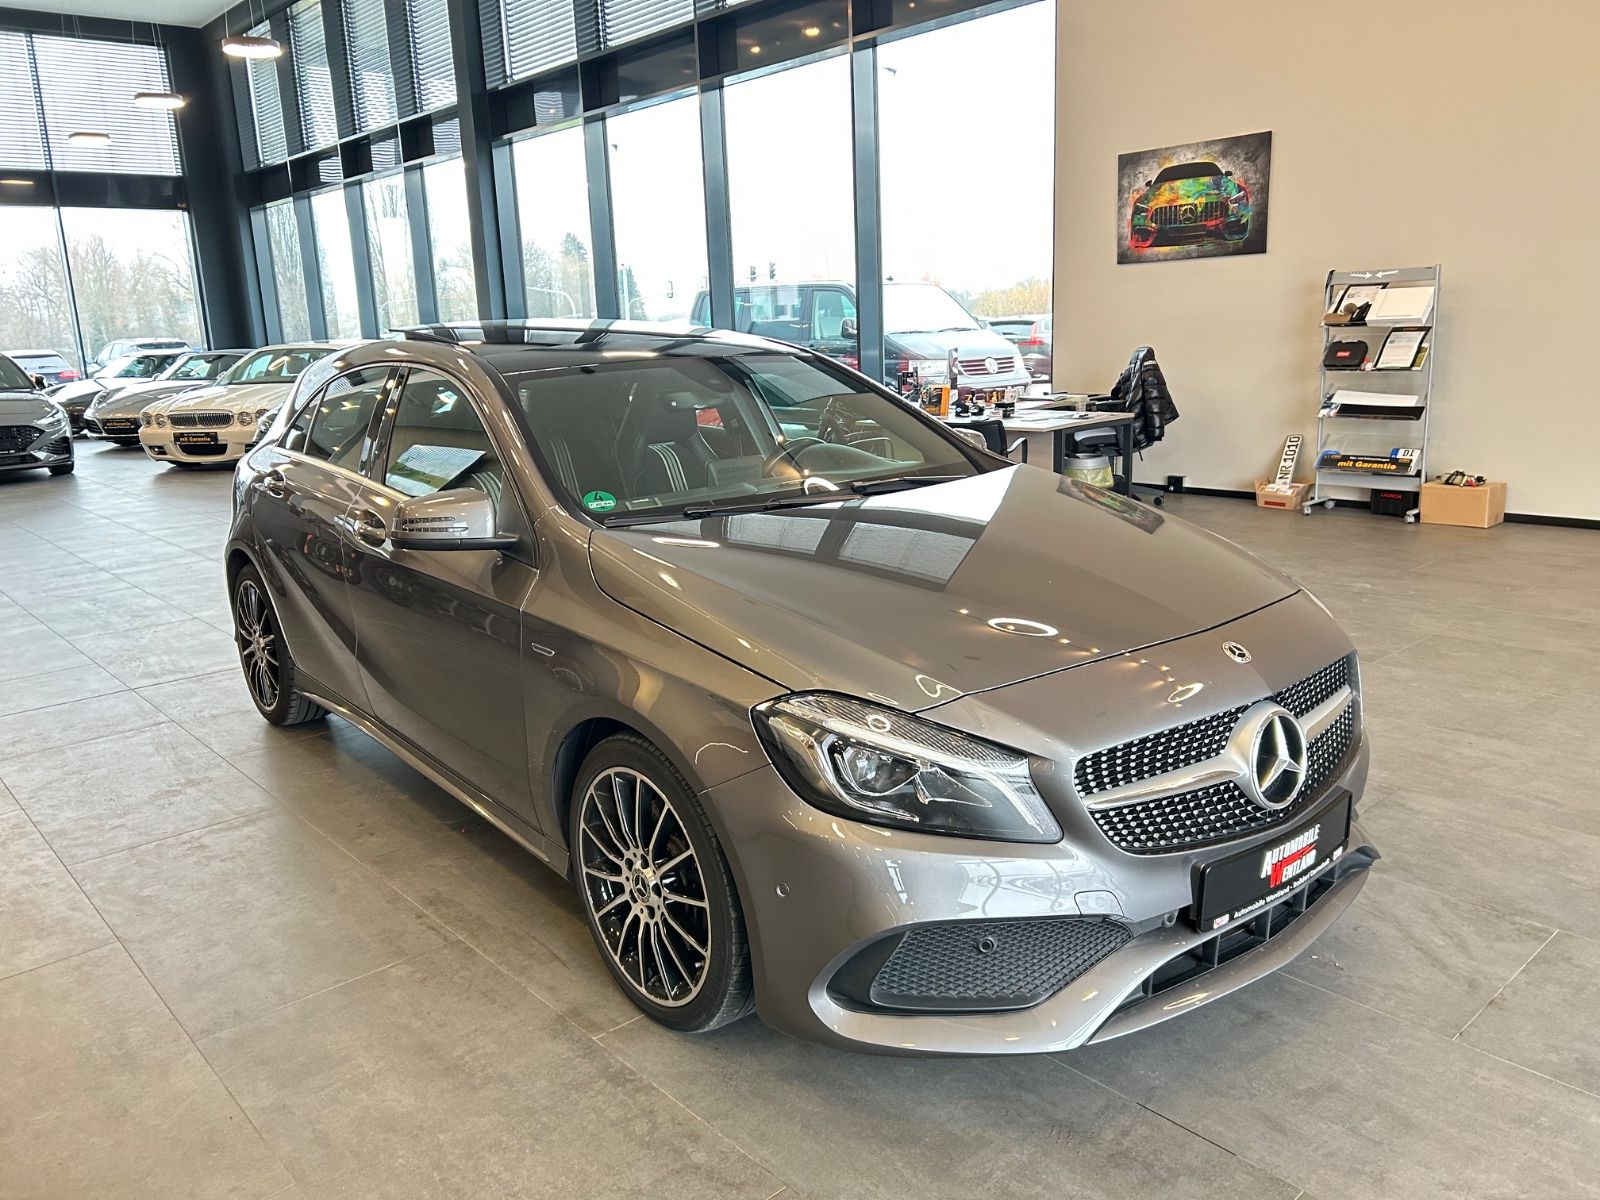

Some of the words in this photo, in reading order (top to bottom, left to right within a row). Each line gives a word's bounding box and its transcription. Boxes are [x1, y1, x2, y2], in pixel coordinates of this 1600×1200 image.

[1283, 436, 1301, 463] 1010
[1355, 461, 1397, 470] Garantie
[594, 491, 603, 501] 4
